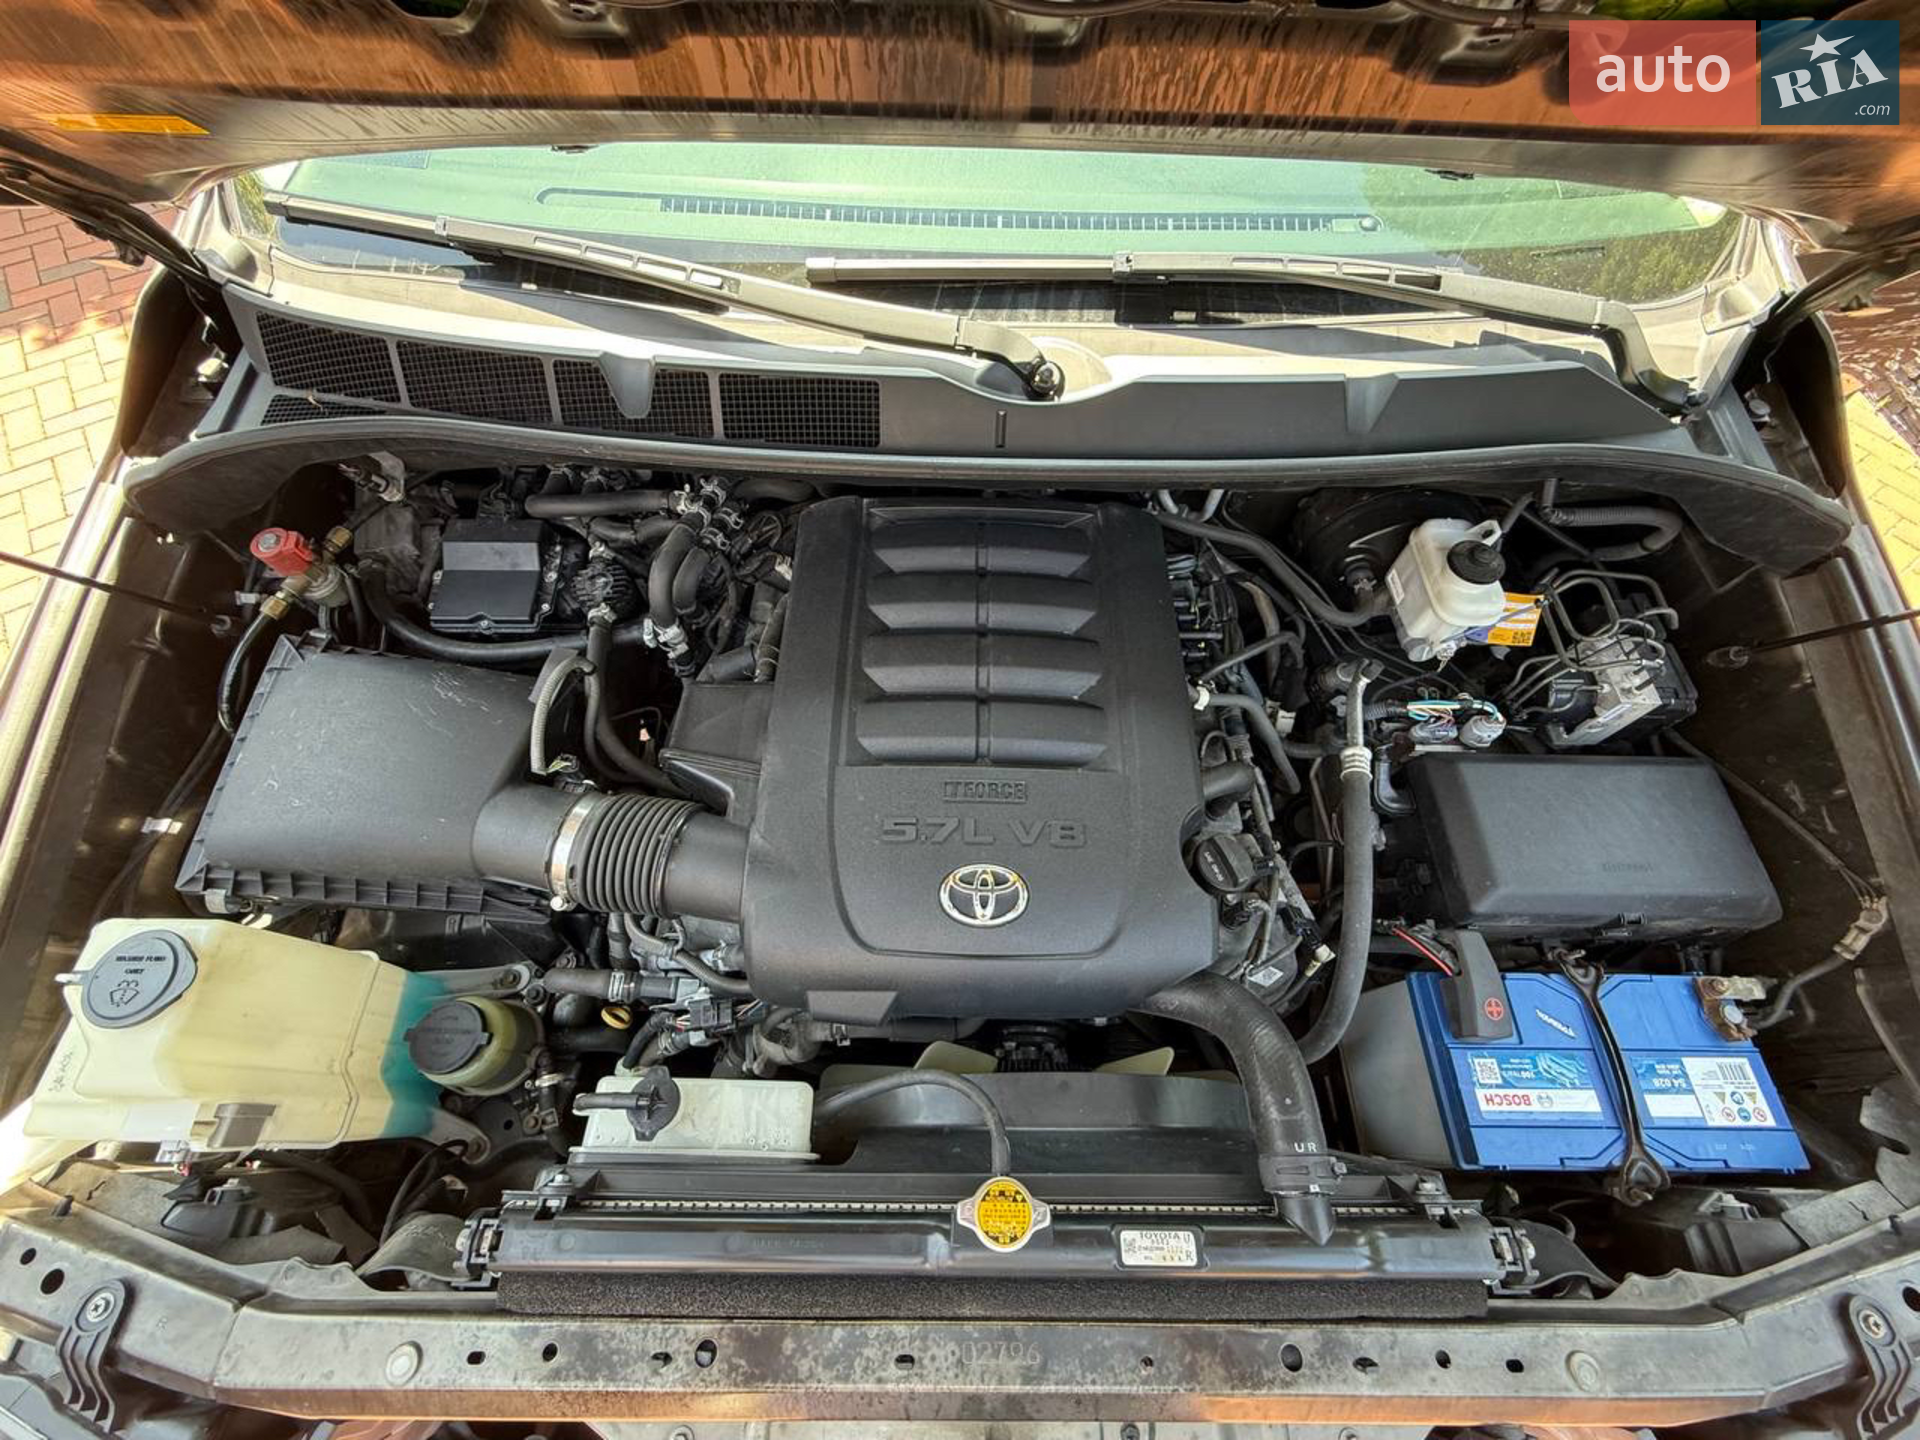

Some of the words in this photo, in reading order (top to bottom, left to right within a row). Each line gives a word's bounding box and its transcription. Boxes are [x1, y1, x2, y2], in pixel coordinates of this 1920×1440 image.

[880, 816, 996, 846] 5.7L
[1007, 819, 1088, 848] V8
[1483, 1093, 1533, 1107] BOSCH
[1139, 1232, 1180, 1240] TOYOTA
